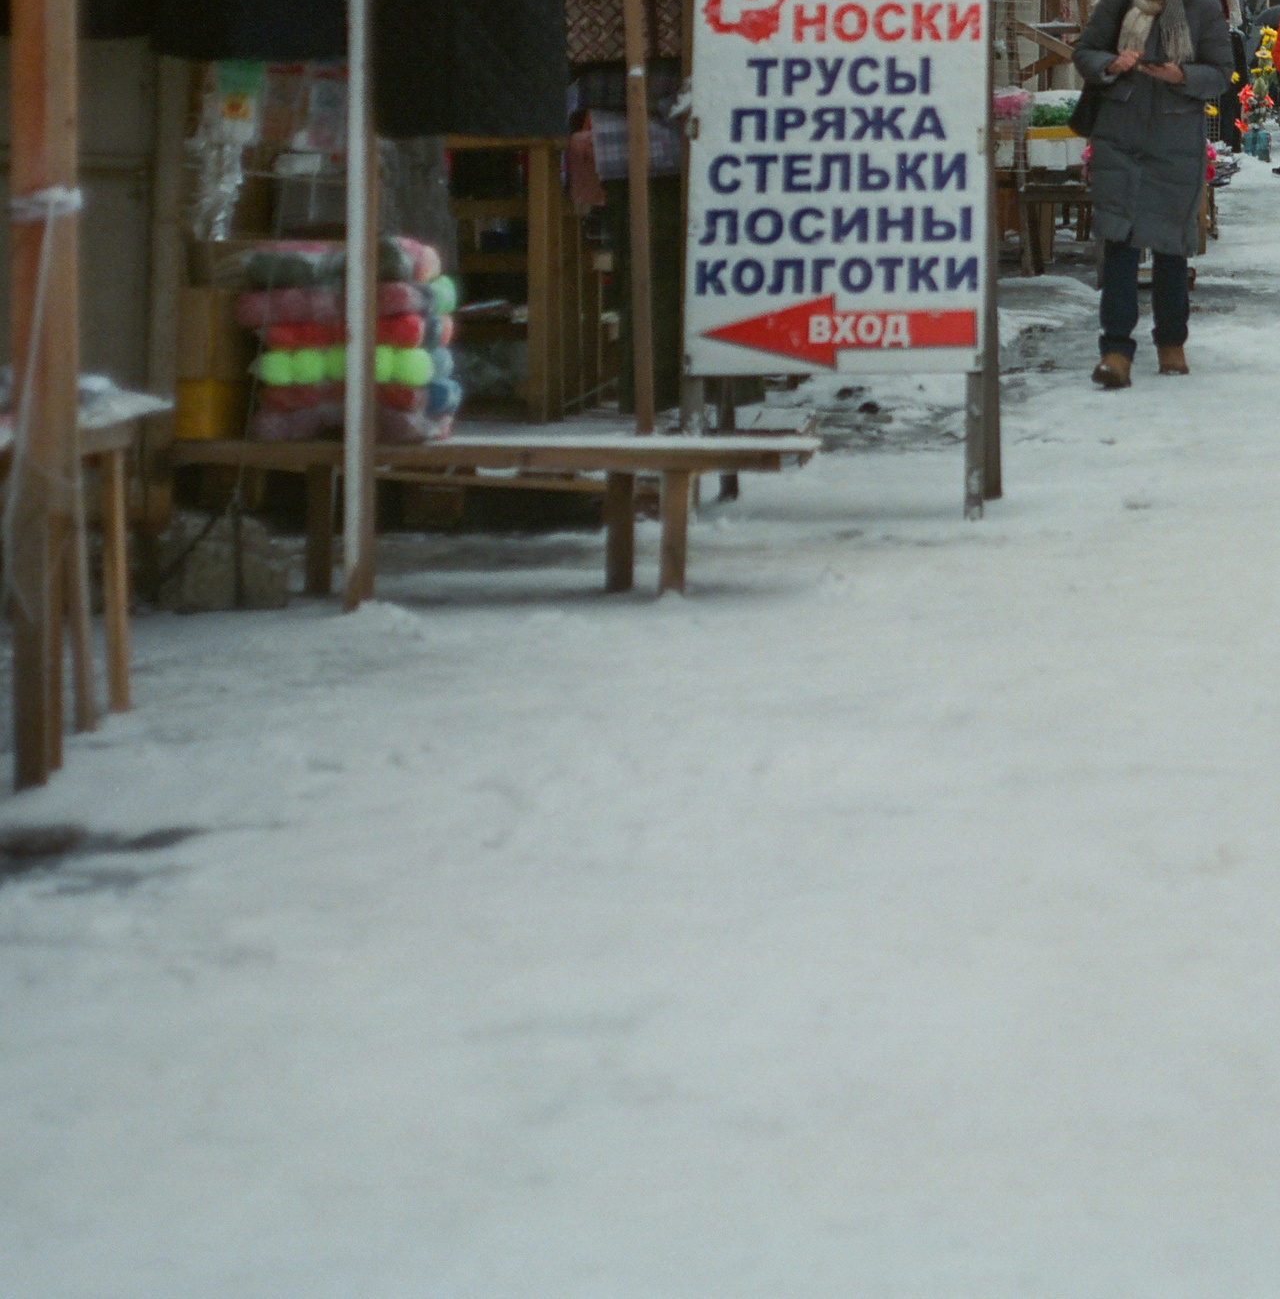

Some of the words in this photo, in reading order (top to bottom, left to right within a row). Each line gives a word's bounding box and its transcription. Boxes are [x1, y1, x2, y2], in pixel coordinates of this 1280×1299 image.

[793, 2, 981, 43] НОСКИ
[746, 56, 931, 97] ТРУСЫ
[730, 106, 947, 143] ПРЯЖА
[708, 152, 967, 195] СТЕЛЬКИ
[699, 206, 973, 247] ЛОСИНЫ
[695, 256, 978, 295] КОЛГОТКИ
[808, 315, 911, 348] ВХОД
